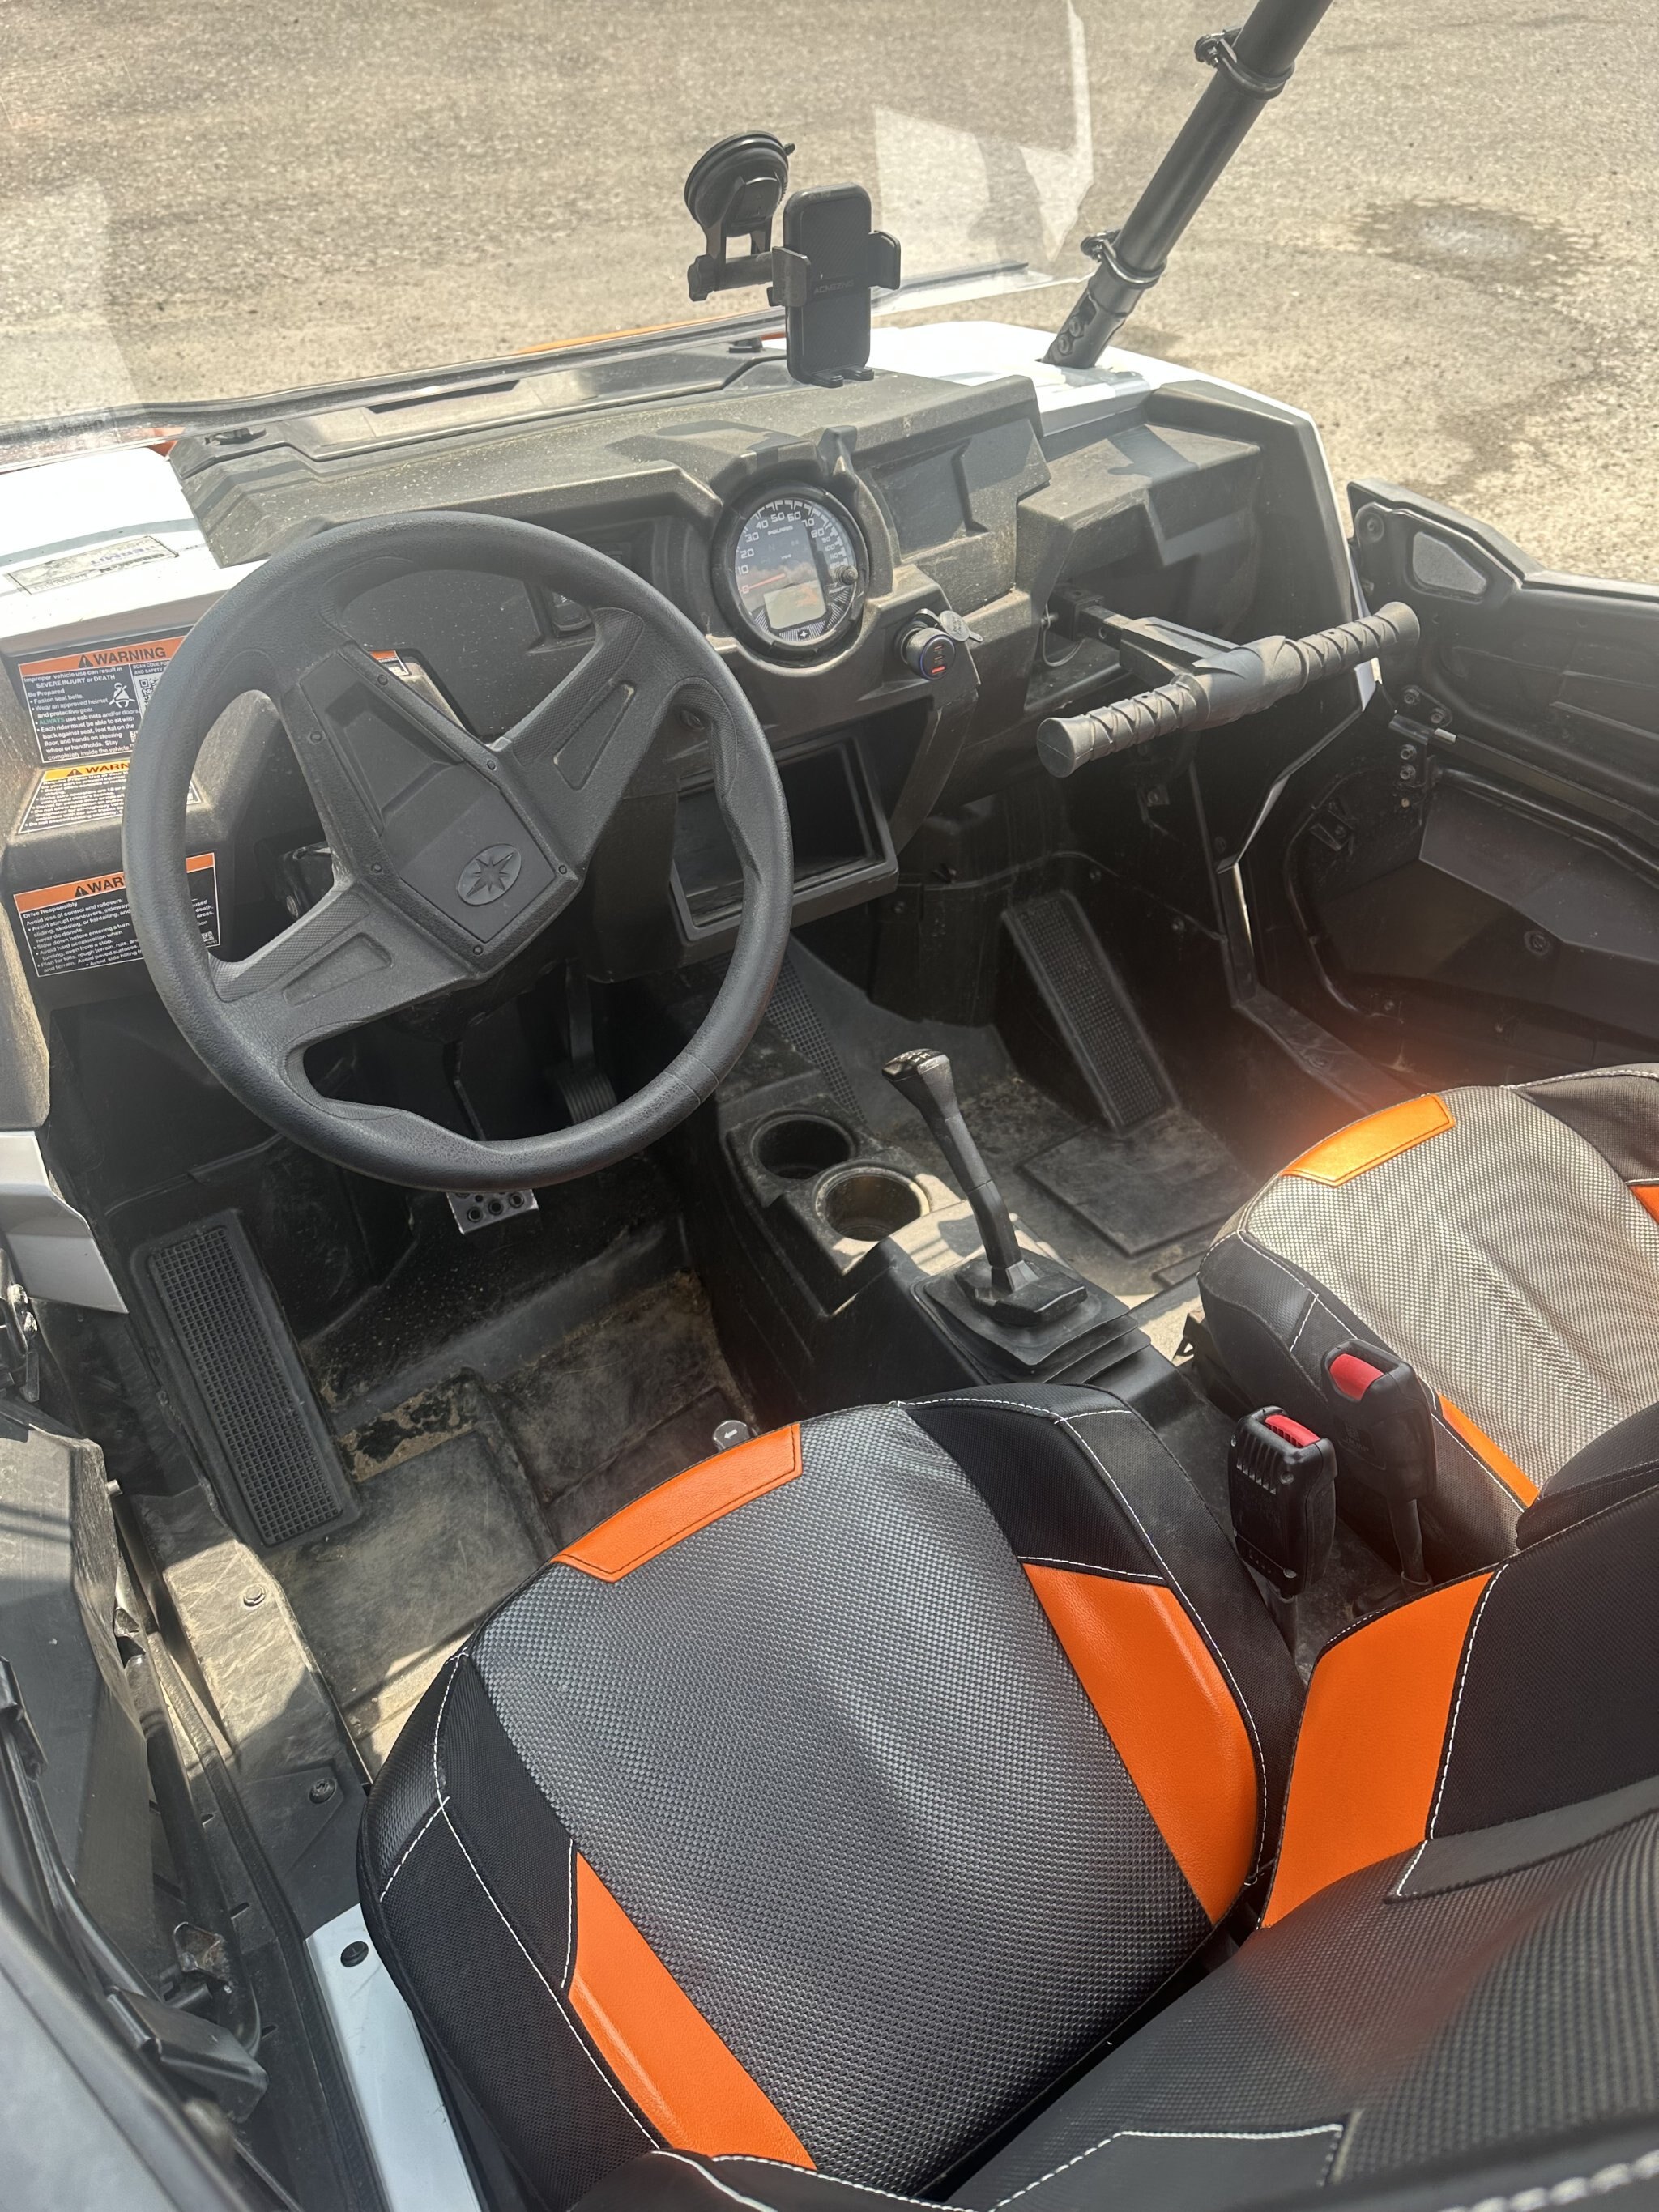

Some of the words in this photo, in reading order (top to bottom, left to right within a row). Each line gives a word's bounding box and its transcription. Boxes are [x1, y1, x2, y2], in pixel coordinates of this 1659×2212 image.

[770, 512, 785, 522] 50
[787, 511, 801, 522] 60
[756, 520, 769, 530] 40
[801, 518, 814, 527] 70
[745, 531, 759, 543] 30
[811, 527, 825, 538] 80
[740, 548, 754, 559] 20
[737, 565, 749, 575] 10
[741, 585, 749, 594] 0
[93, 647, 166, 665] WARNING
[62, 678, 86, 686] INJURY
[38, 688, 65, 697] Prepared
[61, 700, 87, 709] approved
[49, 709, 79, 718] protective
[58, 730, 79, 739] against
[99, 731, 122, 740] steering
[71, 741, 104, 751] handholds.
[48, 751, 80, 761] completely
[87, 876, 125, 893] WAR
[40, 901, 78, 914] Responsibly
[195, 905, 214, 913] death.
[27, 918, 44, 926] Avoid
[64, 908, 85, 917] control
[32, 923, 49, 931] Avoid
[50, 918, 70, 927] abrupt
[69, 933, 88, 941] before
[88, 927, 113, 936] entering
[40, 947, 57, 955] Avoid
[57, 943, 70, 951] hard
[70, 935, 106, 947] acceleration
[107, 930, 123, 938] when
[78, 956, 95, 964] Avoid
[95, 951, 113, 960] paved
[90, 958, 106, 966] Avoid
